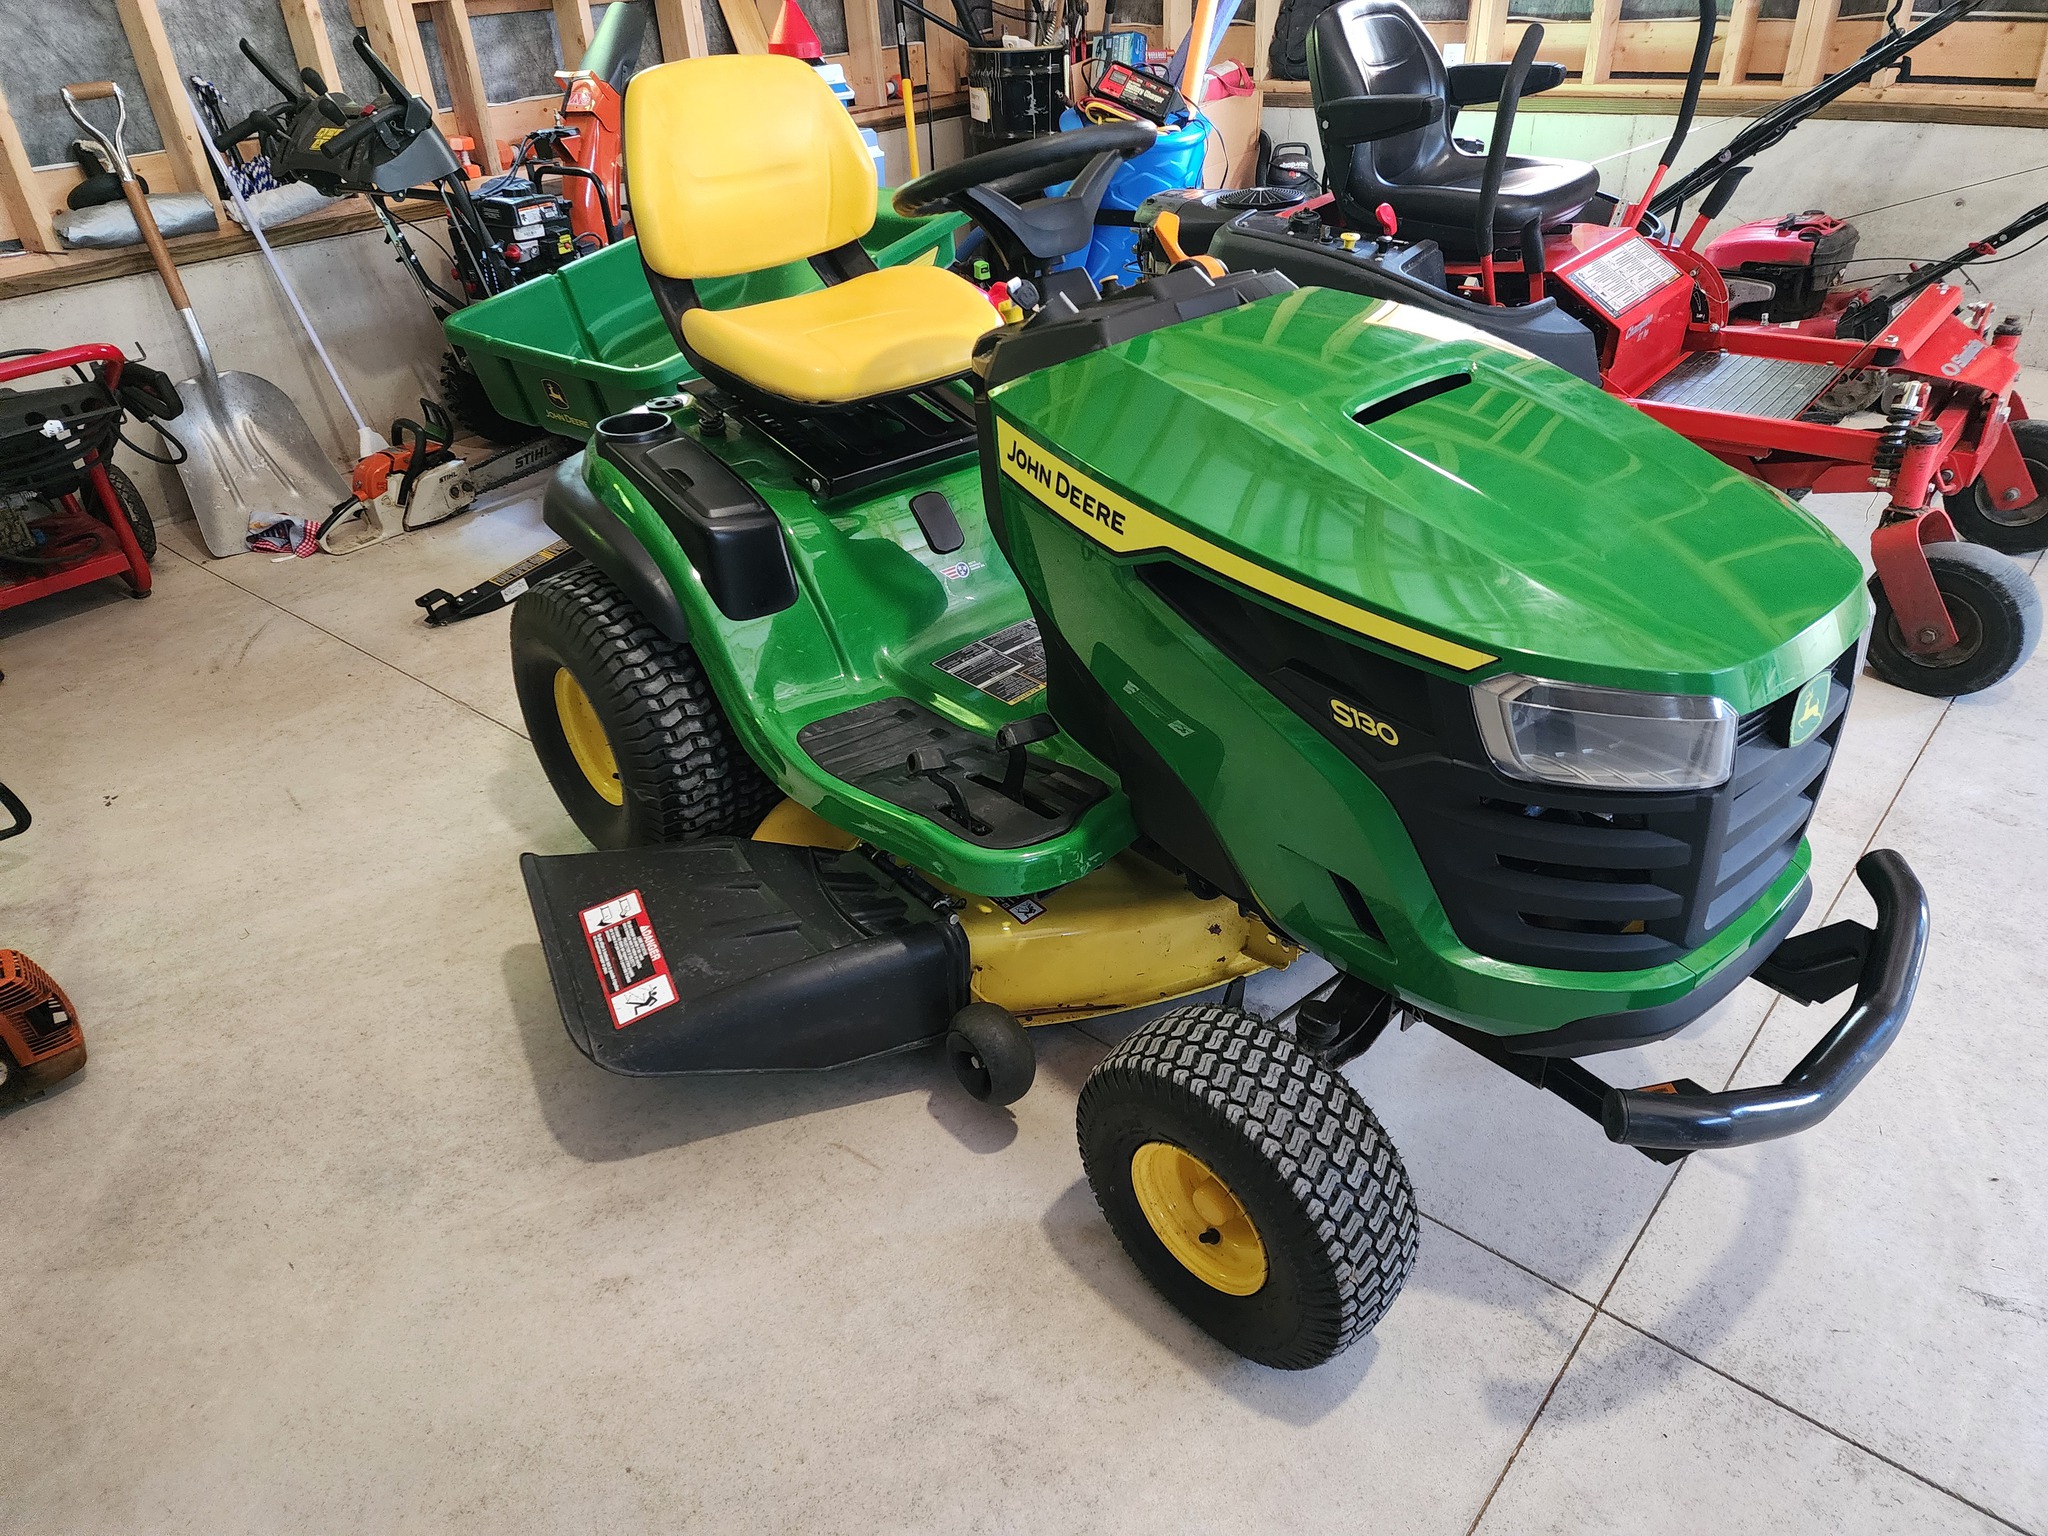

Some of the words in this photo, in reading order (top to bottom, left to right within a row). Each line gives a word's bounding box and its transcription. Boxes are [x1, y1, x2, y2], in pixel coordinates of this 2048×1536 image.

[1125, 82, 1145, 96] Battery
[1143, 89, 1165, 104] Charger
[546, 408, 567, 423] JOHN
[565, 414, 592, 430] DEERE
[514, 444, 553, 470] STIHL
[439, 471, 458, 484] STIHL
[1007, 439, 1052, 490] JOHN
[1055, 470, 1126, 536] DEERE
[1330, 698, 1400, 747] S130
[642, 927, 662, 962] DANGER
